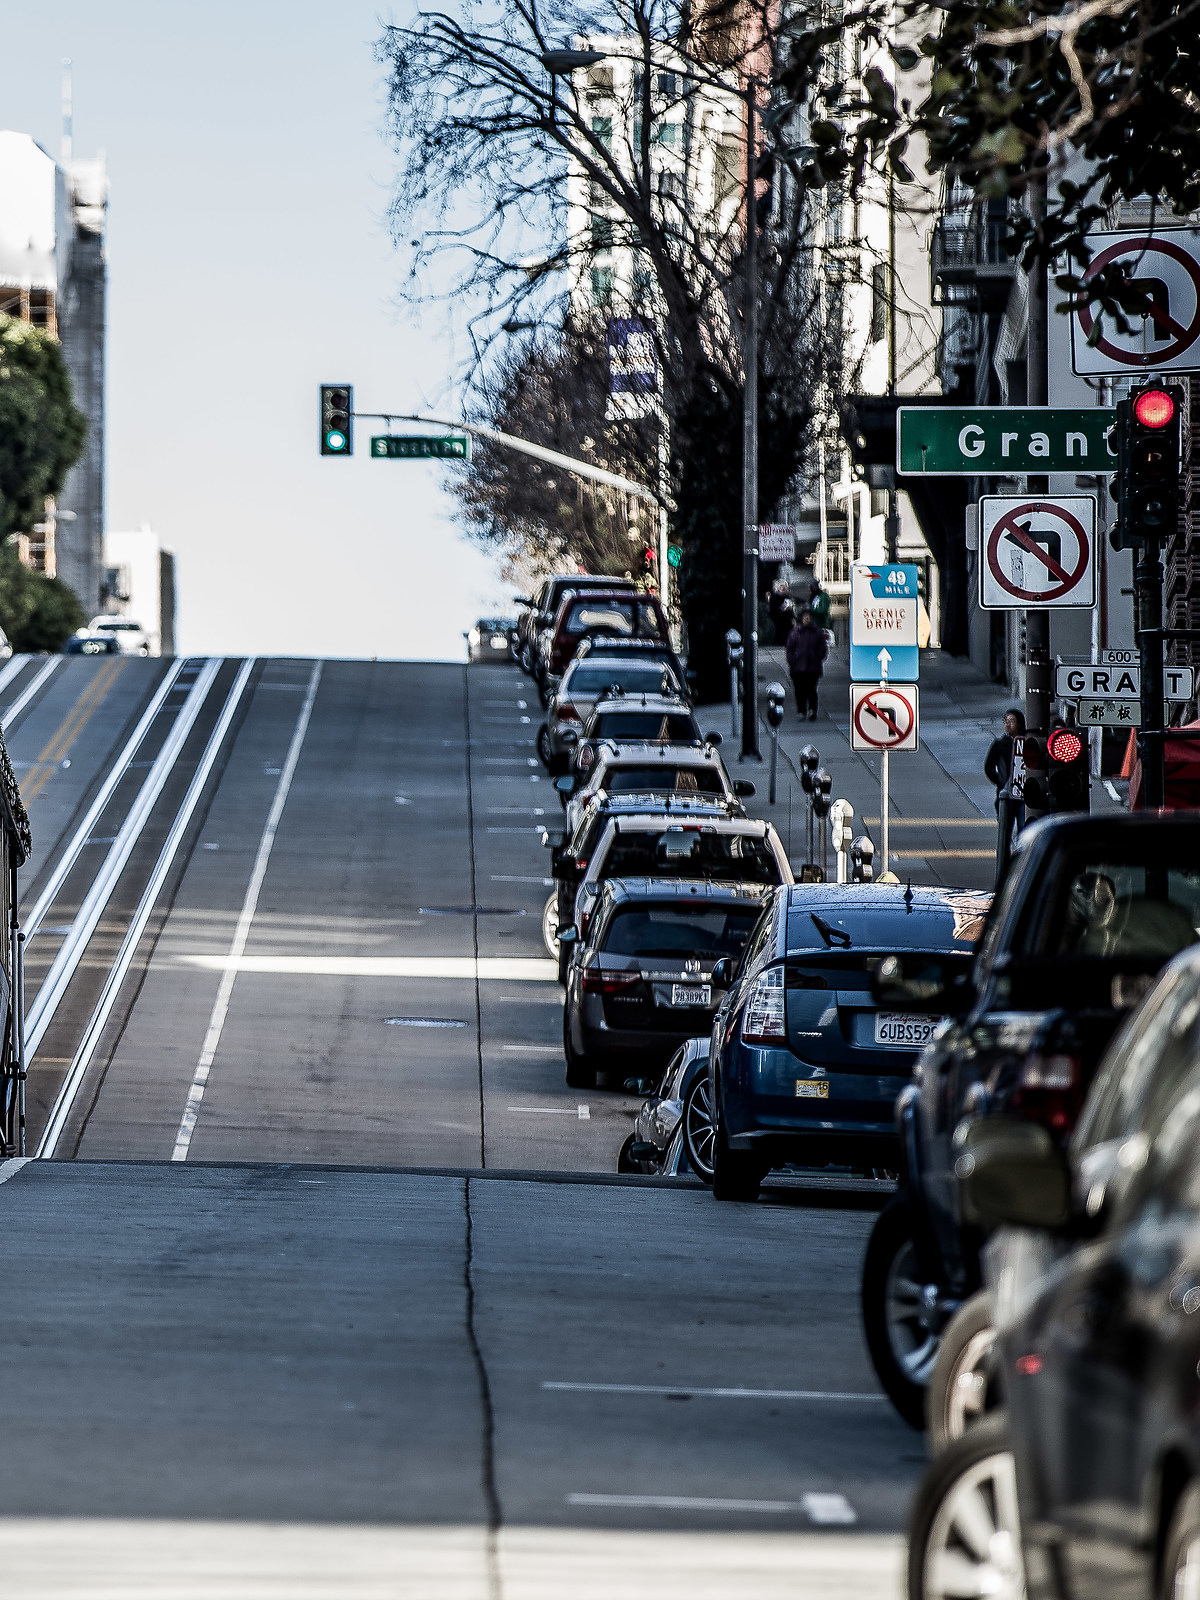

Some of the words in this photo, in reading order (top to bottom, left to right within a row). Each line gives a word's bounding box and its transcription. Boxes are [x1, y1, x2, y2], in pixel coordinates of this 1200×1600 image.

[887, 570, 906, 585] 49
[884, 585, 910, 595] MILE
[863, 607, 906, 619] SCENIC
[866, 618, 903, 630] DRIVE
[1108, 651, 1132, 662] 600
[1067, 670, 1183, 694] GRAT
[1088, 704, 1133, 721] 都板
